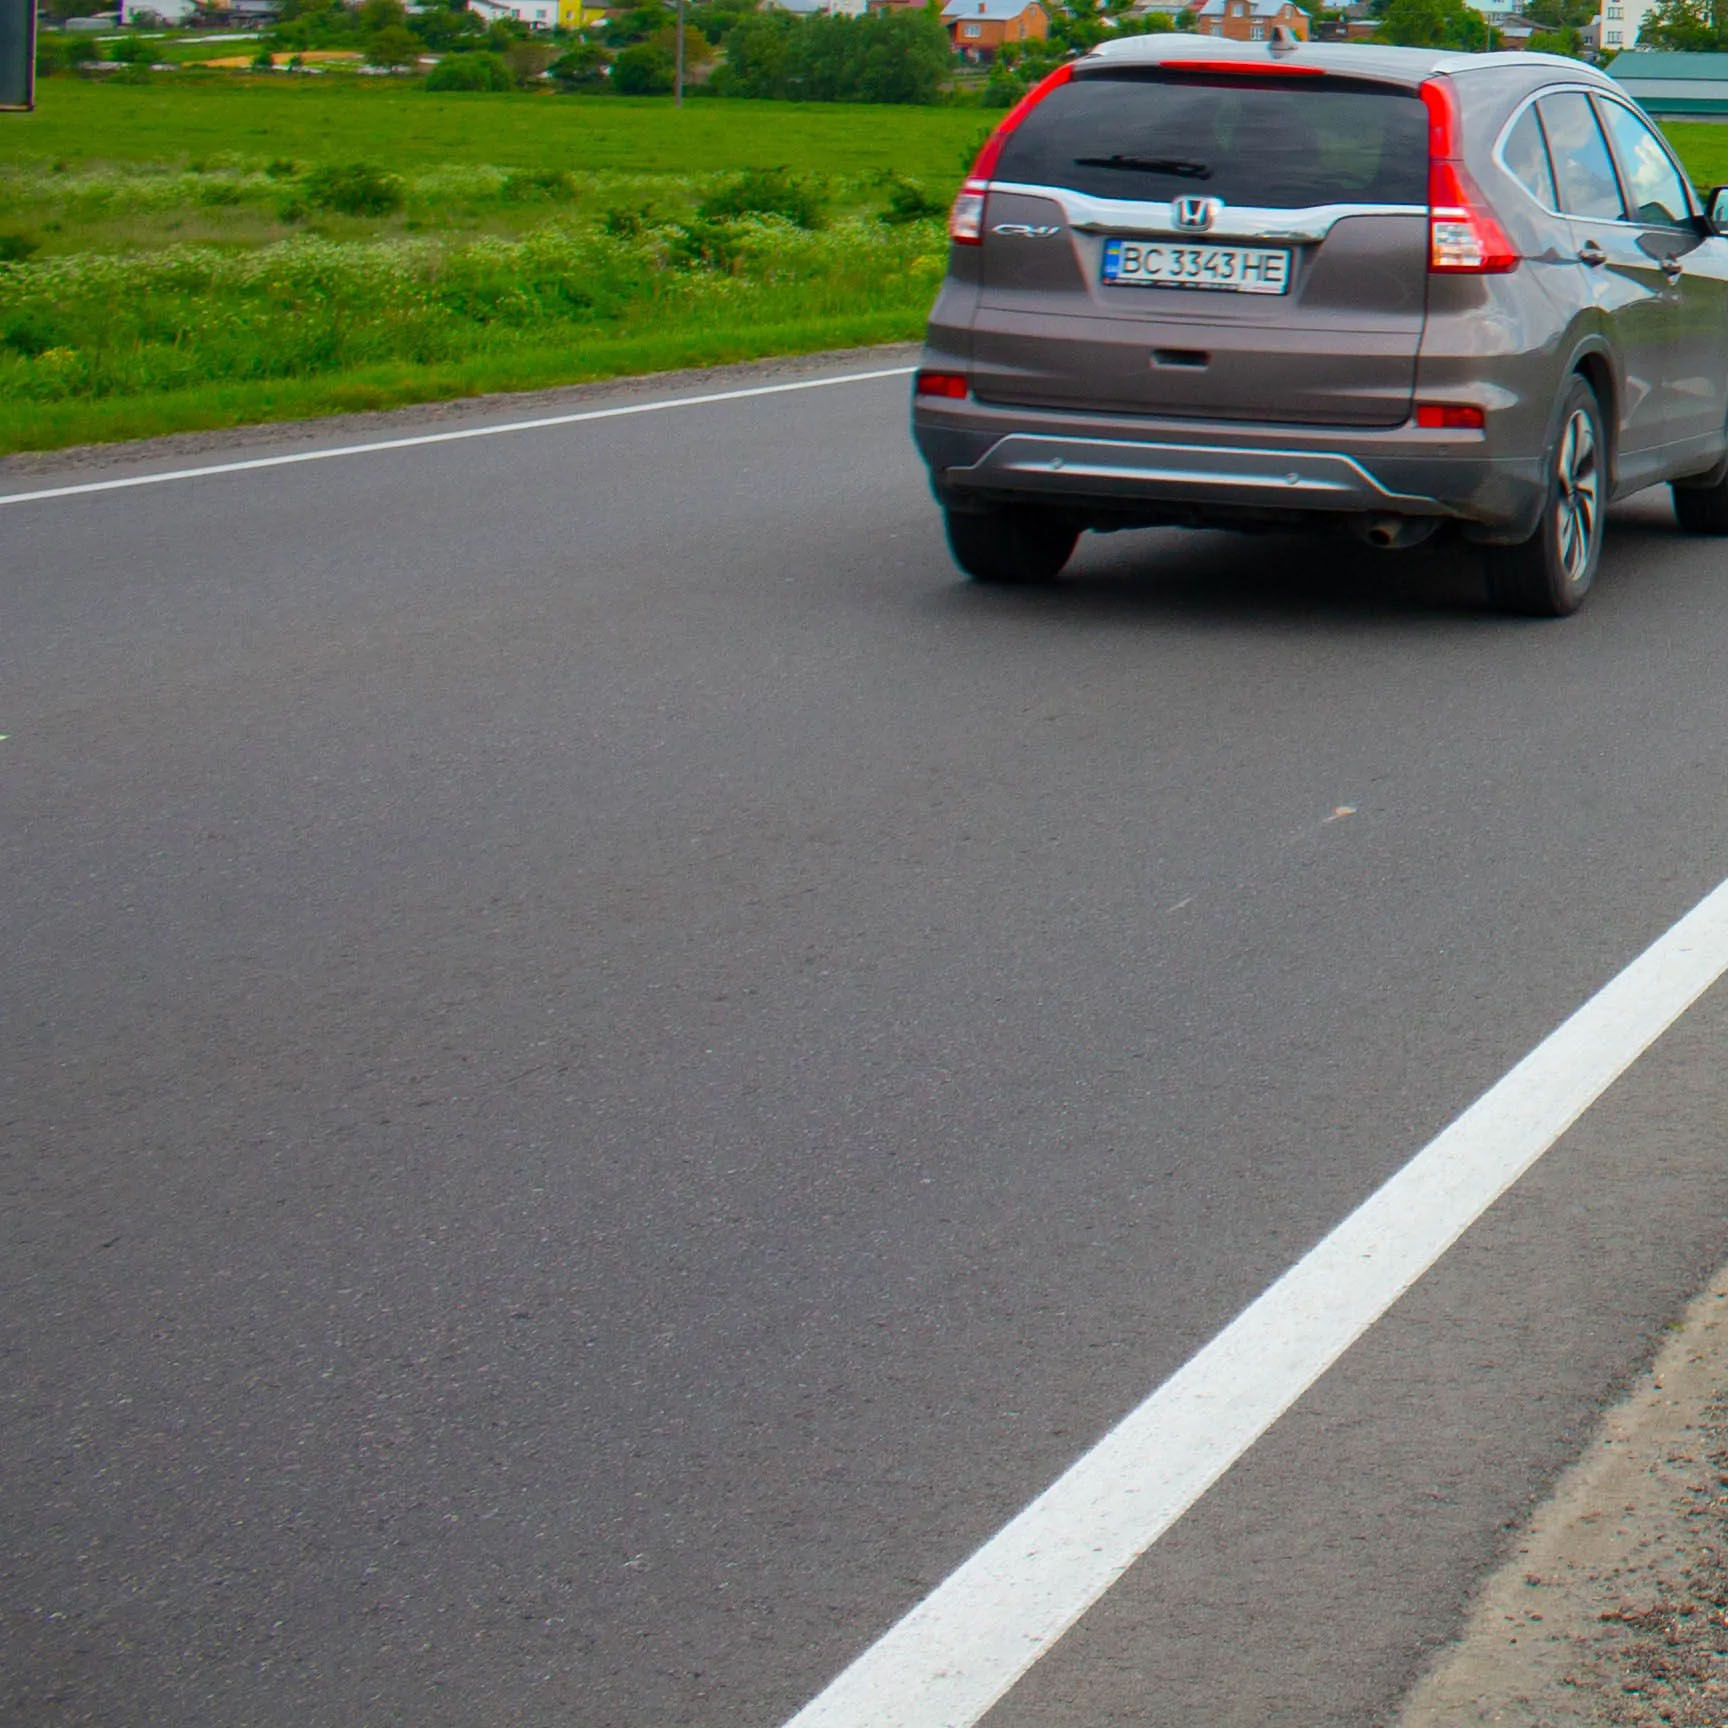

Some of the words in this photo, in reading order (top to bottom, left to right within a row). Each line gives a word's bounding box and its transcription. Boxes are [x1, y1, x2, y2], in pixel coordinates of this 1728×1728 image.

[1122, 246, 1164, 275] BC
[1172, 248, 1236, 280] 3343
[1240, 252, 1286, 283] HE
